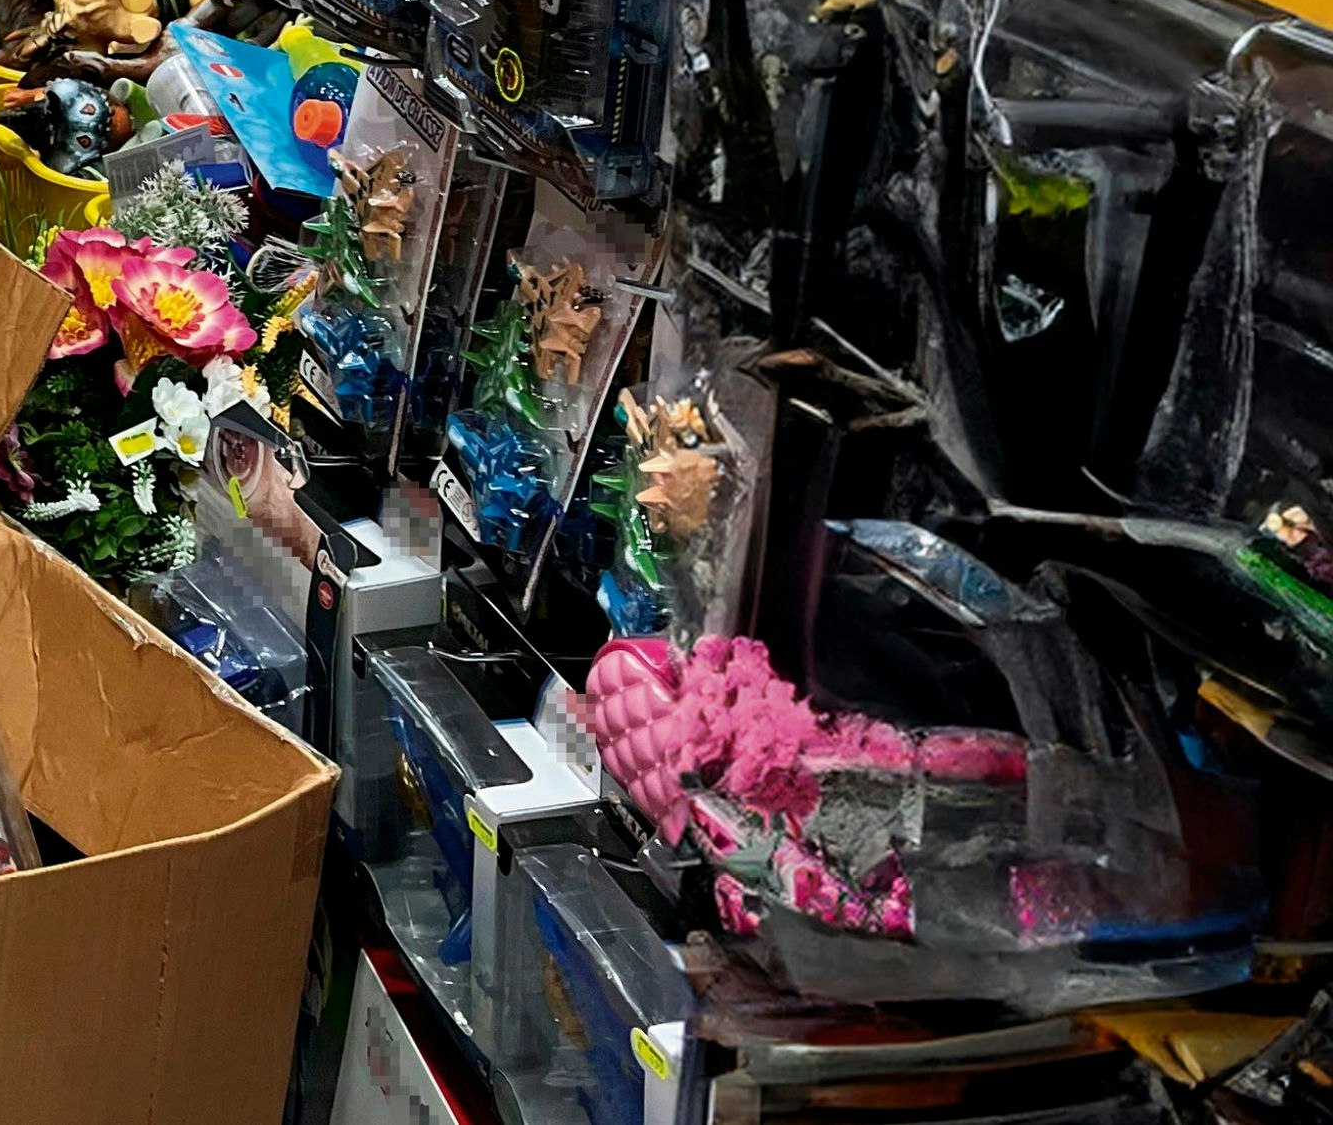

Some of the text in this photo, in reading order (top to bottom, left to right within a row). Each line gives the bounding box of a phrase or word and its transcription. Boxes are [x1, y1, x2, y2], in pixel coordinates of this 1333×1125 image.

[369, 64, 396, 101] AVION
[395, 84, 410, 112] DE
[407, 97, 442, 146] CHASSE
